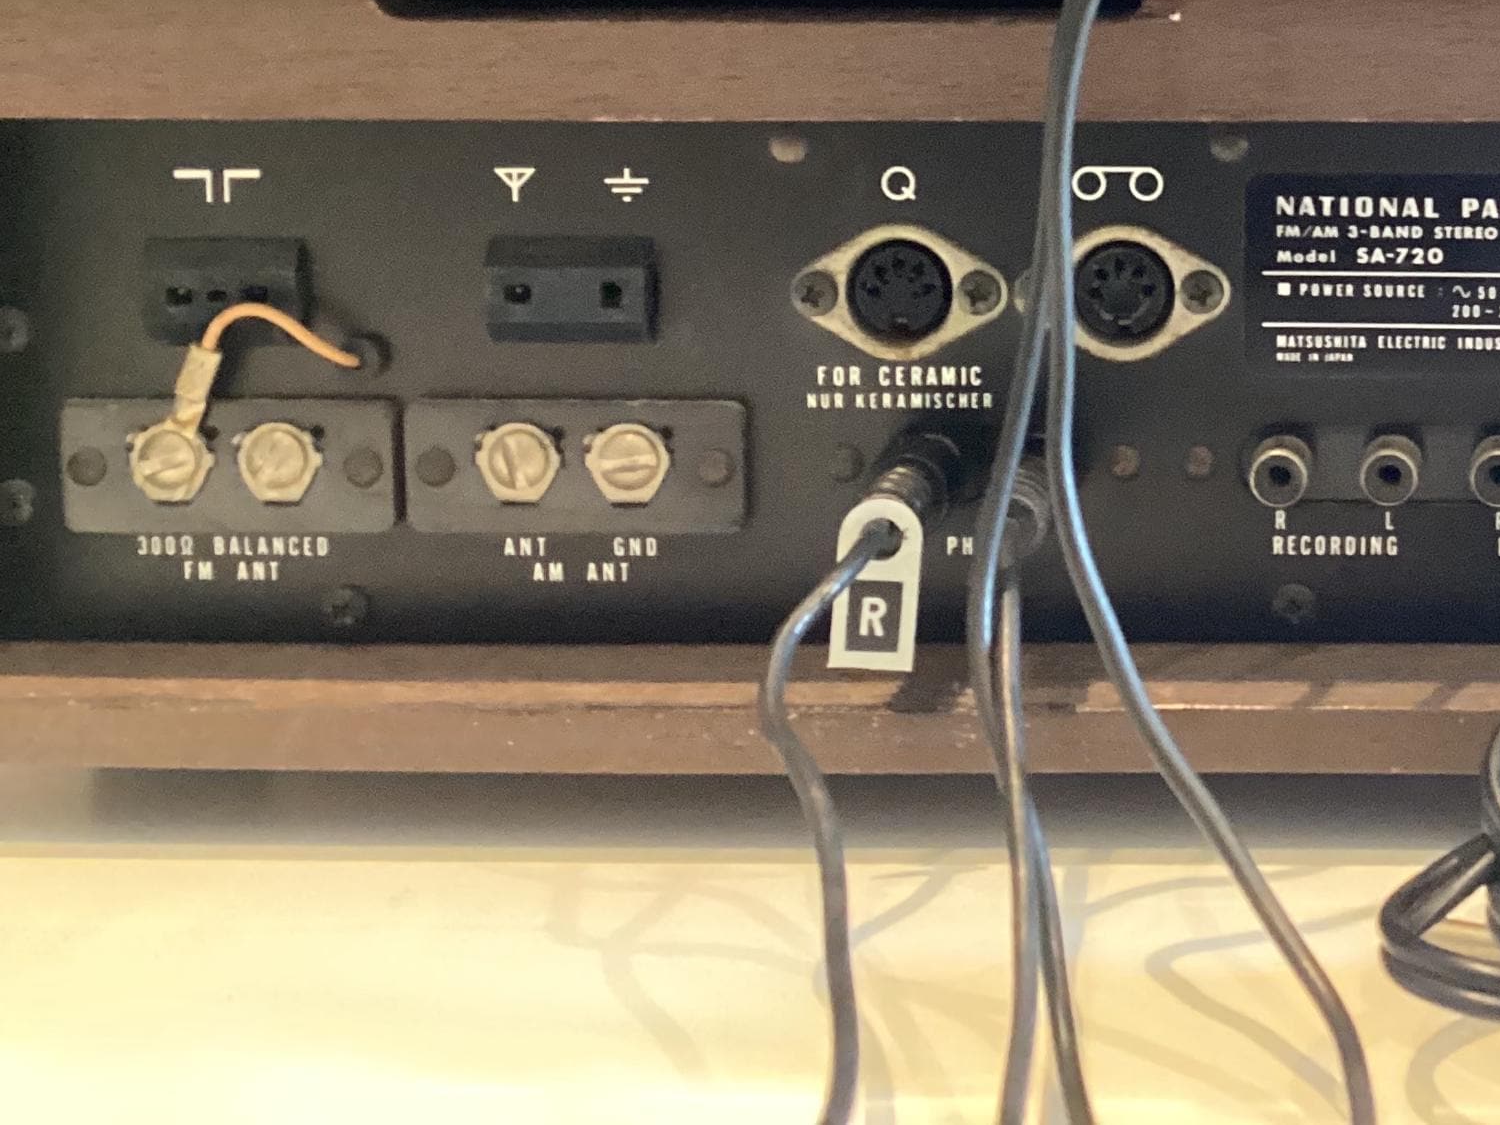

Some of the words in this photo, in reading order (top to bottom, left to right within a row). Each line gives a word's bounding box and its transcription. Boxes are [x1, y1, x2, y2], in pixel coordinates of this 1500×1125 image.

[1276, 195, 1440, 219] NATIONAL
[1276, 224, 1339, 239] FM/AM
[1347, 224, 1424, 239] 3-BAND
[1433, 225, 1499, 241] STEREO
[1276, 249, 1336, 264] Model
[1356, 246, 1444, 265] SA-720
[1299, 282, 1354, 297] POWER
[1363, 283, 1425, 299] SOURCE
[1477, 285, 1497, 300] 50
[1276, 334, 1367, 349] MATSUSHITA
[1377, 335, 1446, 350] ELECTRIC
[816, 365, 861, 387] FOR
[878, 365, 982, 387] CERAMIC
[806, 392, 844, 409] NUR
[854, 392, 992, 410] KERAMISCHER
[1274, 509, 1286, 530] R
[1384, 511, 1395, 531] L
[212, 535, 329, 557] BALANCED
[503, 536, 546, 557] ANT
[613, 536, 657, 557] GND
[1271, 535, 1398, 556] RECORDING
[183, 560, 213, 581] FM
[237, 560, 279, 581] ANT
[532, 562, 564, 582] AM
[586, 562, 629, 582] ANT
[859, 596, 888, 637] R
